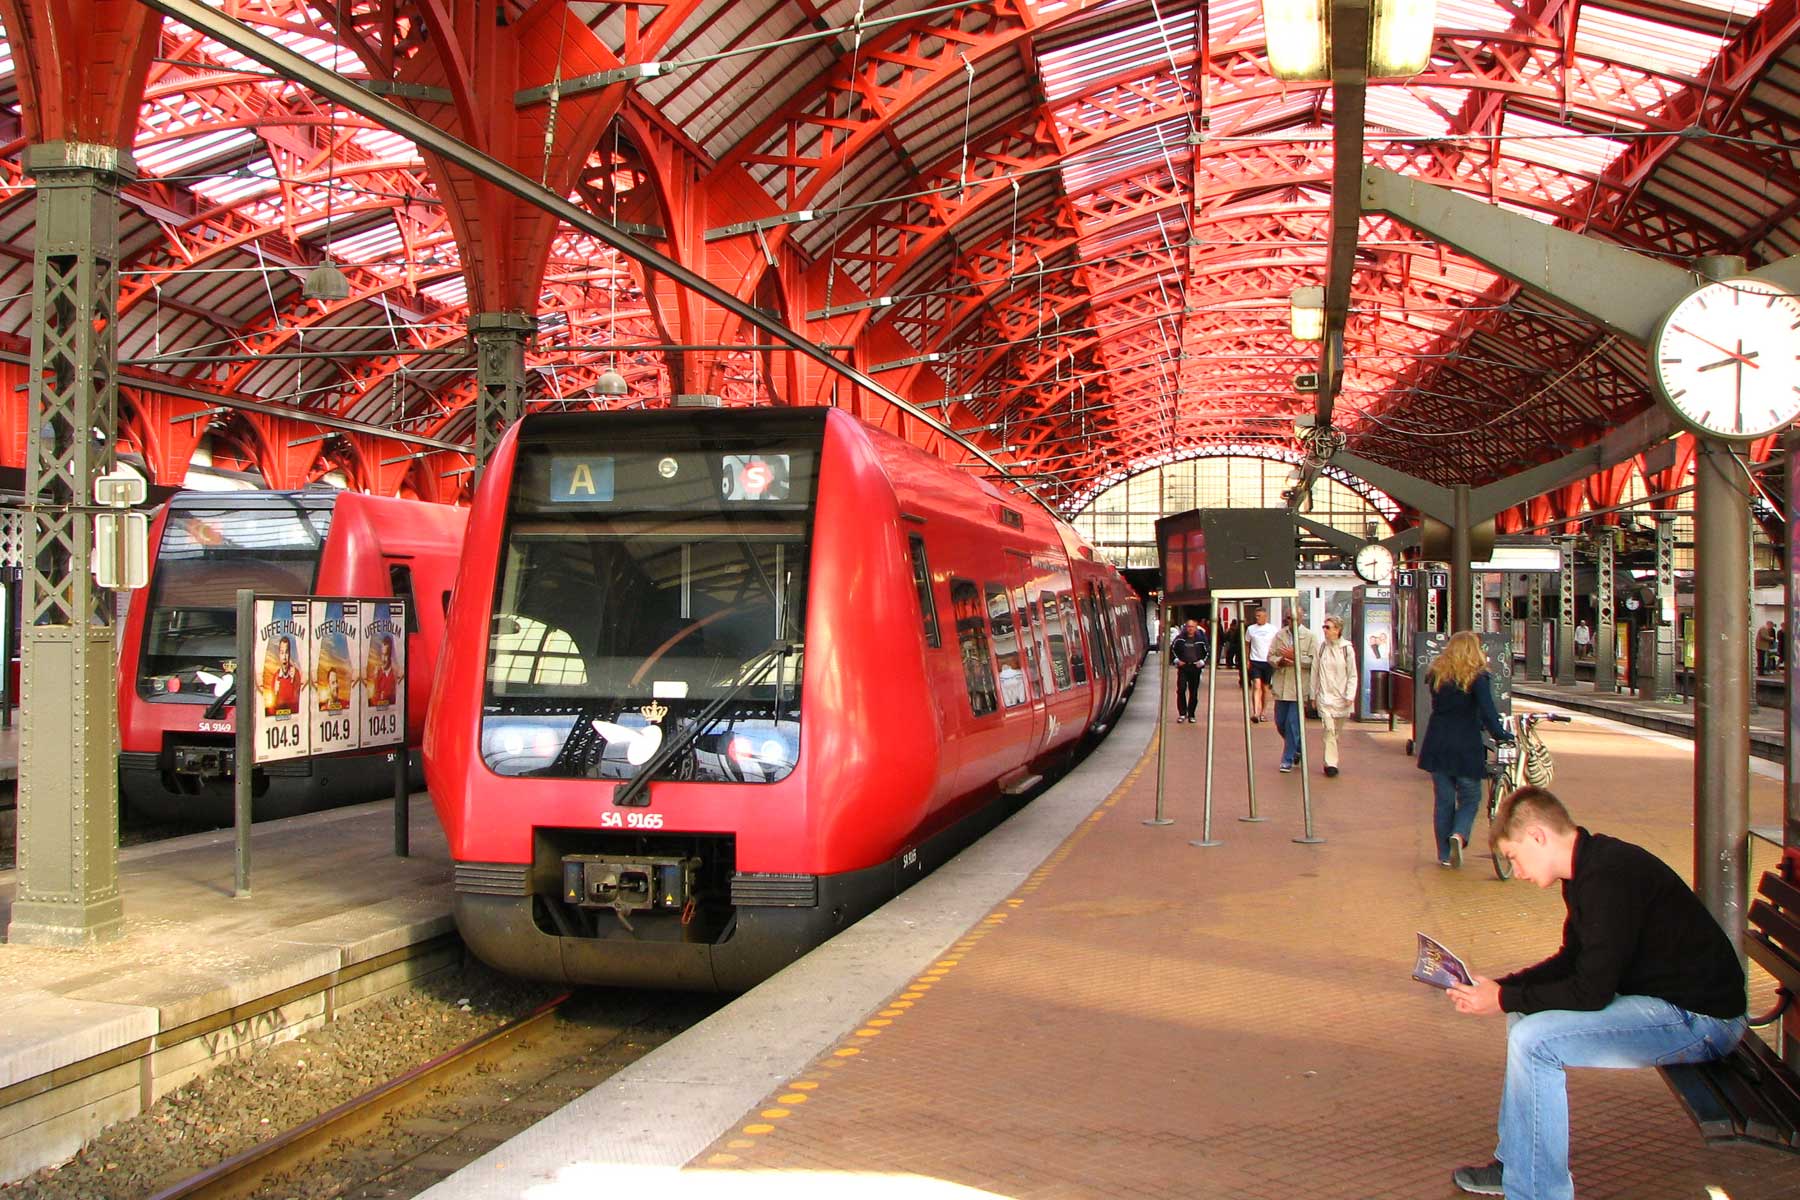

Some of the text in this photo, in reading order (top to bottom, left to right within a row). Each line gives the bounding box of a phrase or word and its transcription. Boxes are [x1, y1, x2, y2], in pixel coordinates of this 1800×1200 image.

[569, 463, 596, 495] A
[747, 467, 767, 488] S
[260, 620, 306, 641] UFFE HOLM
[314, 620, 357, 640] UFFE HOLM
[364, 620, 402, 639] UFFE HOLM
[198, 722, 232, 732] SA 9149
[320, 719, 350, 742] 104.9
[368, 714, 397, 736] 104.9
[266, 724, 300, 749] 104.9
[601, 812, 664, 829] SA 9165
